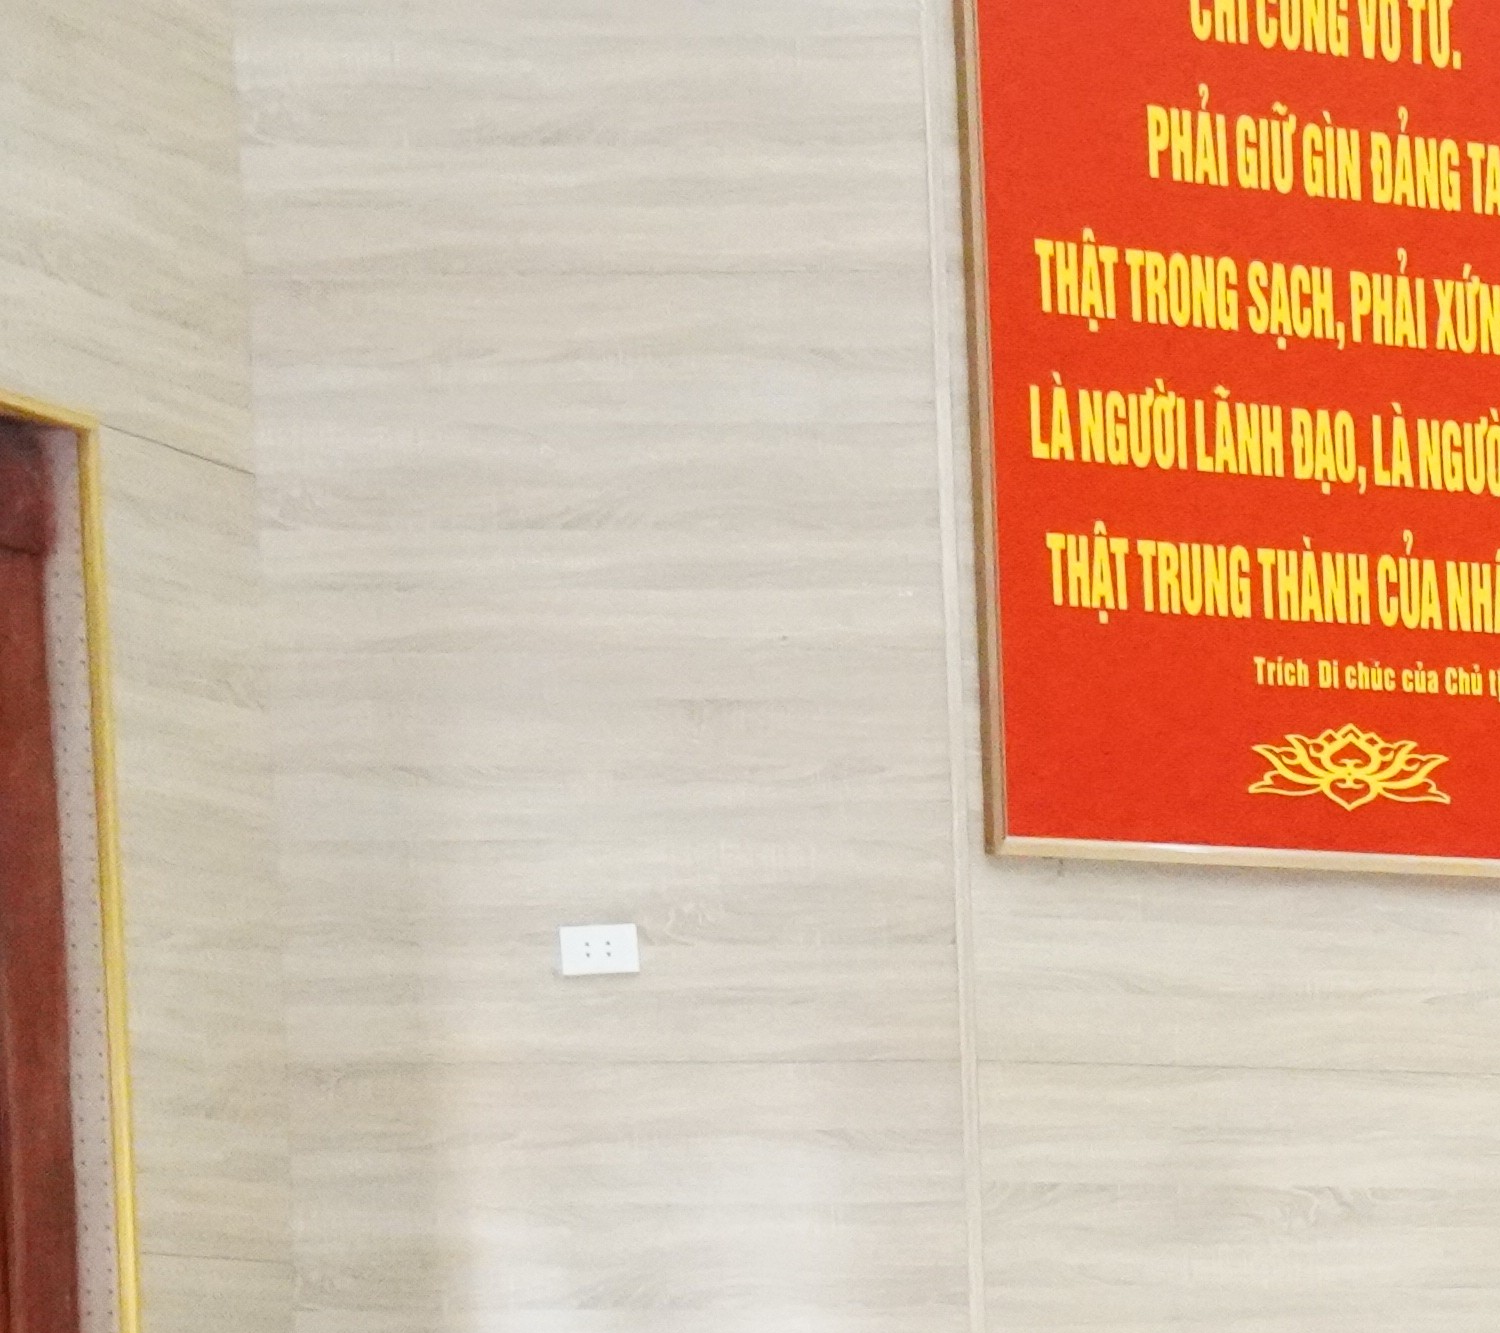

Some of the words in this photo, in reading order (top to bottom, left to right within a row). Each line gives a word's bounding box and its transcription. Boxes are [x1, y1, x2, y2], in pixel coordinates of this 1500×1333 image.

[1146, 83, 1229, 187] PHẢI
[1235, 101, 1297, 194] GIỮ
[1302, 110, 1362, 201] GÌN
[1370, 106, 1462, 212] ĐẢNG
[1034, 228, 1118, 332] THẬT
[1125, 248, 1239, 331] TRONG
[1247, 259, 1345, 350] SẠCH,
[1350, 247, 1427, 349] PHẢI
[1029, 370, 1075, 461] LÀ
[1078, 378, 1188, 470] NGƯỜI
[1194, 384, 1285, 478] LÃNH
[1291, 407, 1366, 495] ĐẠO,
[1372, 402, 1414, 488] LÀ
[1046, 520, 1129, 624] THẬT
[1137, 539, 1251, 618] TRUNG
[1257, 535, 1370, 625] THÀNH
[1377, 529, 1443, 630] CỦA
[1253, 656, 1309, 687] Trích
[1318, 659, 1339, 689] Di
[1345, 658, 1396, 691] chúc
[1401, 661, 1439, 693] của
[1445, 664, 1482, 696] Chủ
